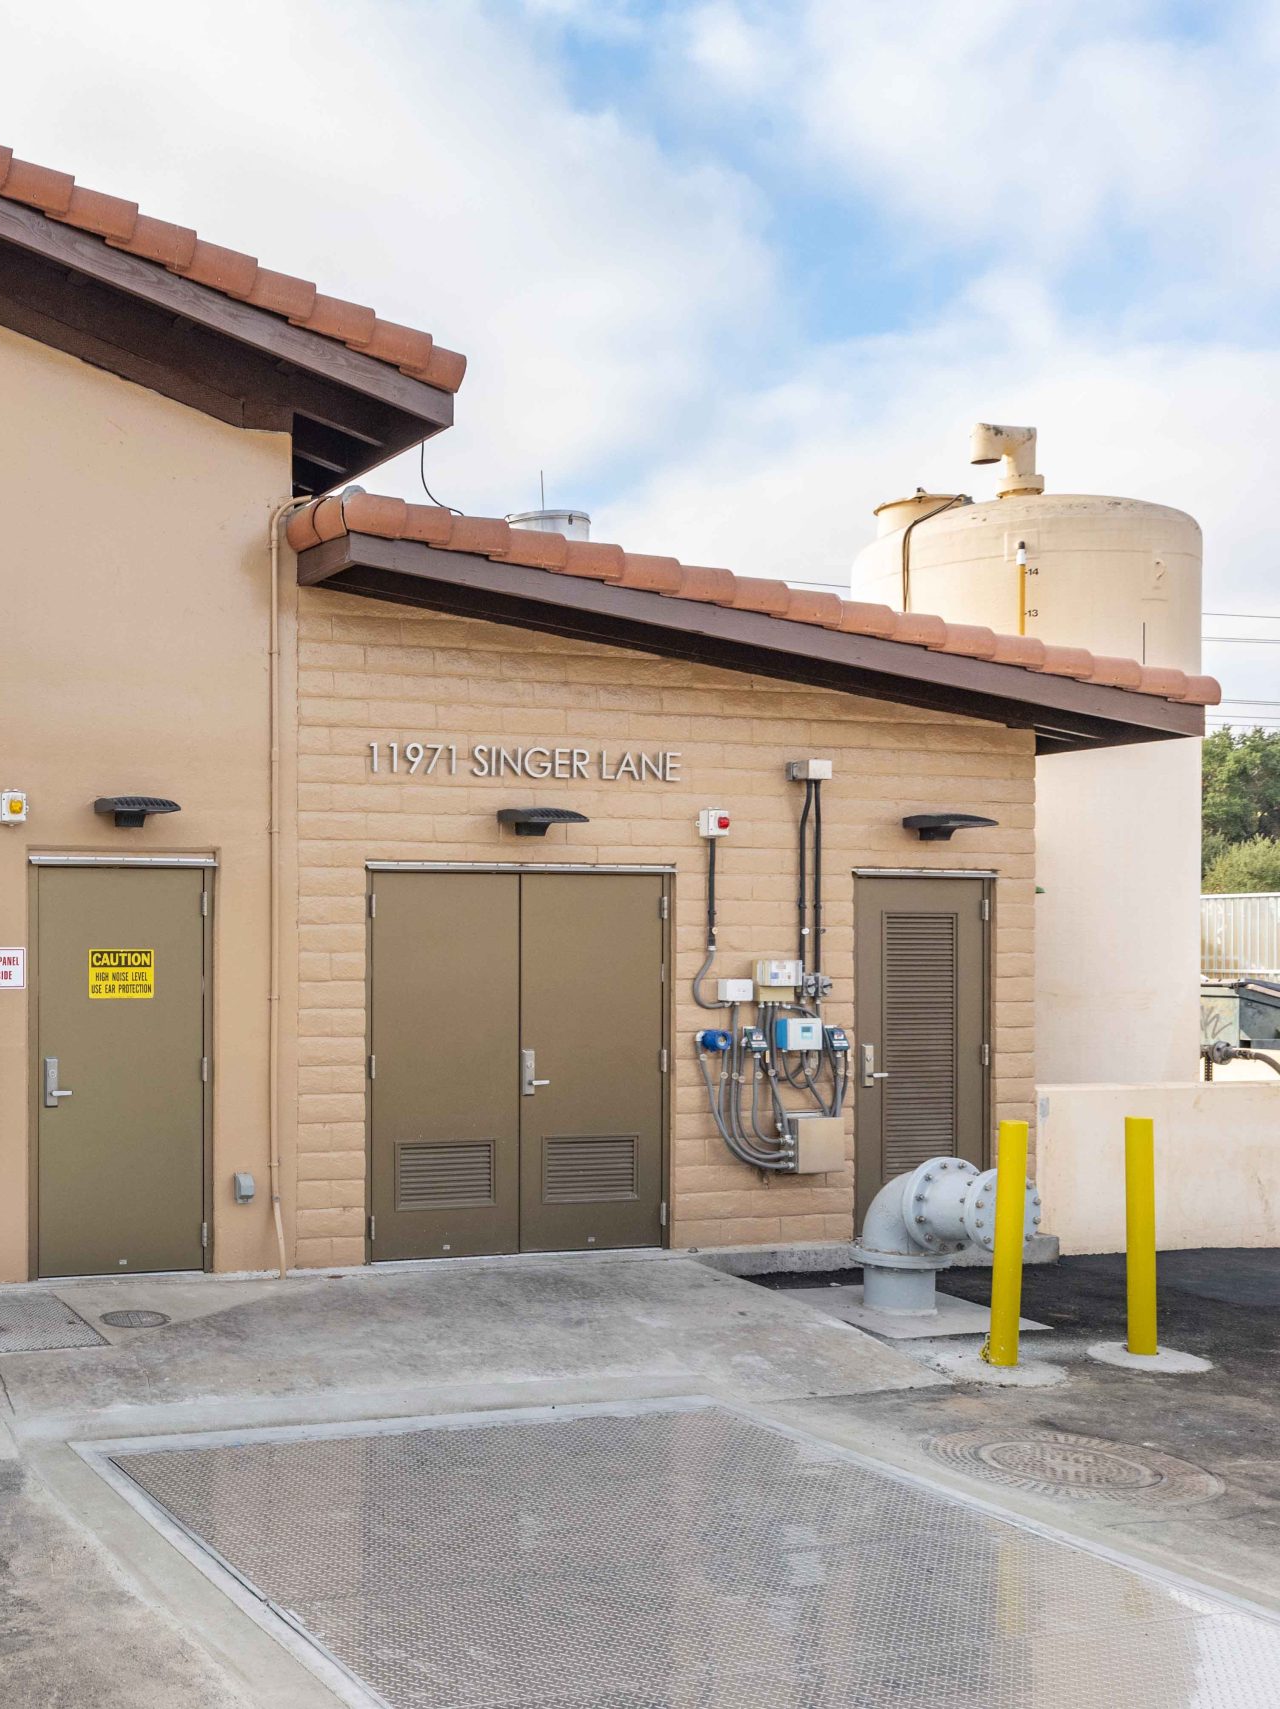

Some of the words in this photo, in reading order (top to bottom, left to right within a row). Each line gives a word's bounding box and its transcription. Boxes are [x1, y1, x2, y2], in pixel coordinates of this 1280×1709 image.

[368, 742, 457, 775] 11971
[472, 745, 590, 779] SINGER
[600, 750, 682, 782] LANE
[92, 952, 151, 966] CAUTION
[95, 971, 110, 982] HIGH
[111, 971, 130, 982] NOISE
[131, 971, 148, 982] LEVEL
[91, 984, 104, 994] USE
[104, 984, 116, 994] EAR
[118, 983, 152, 994] PROTECTION
